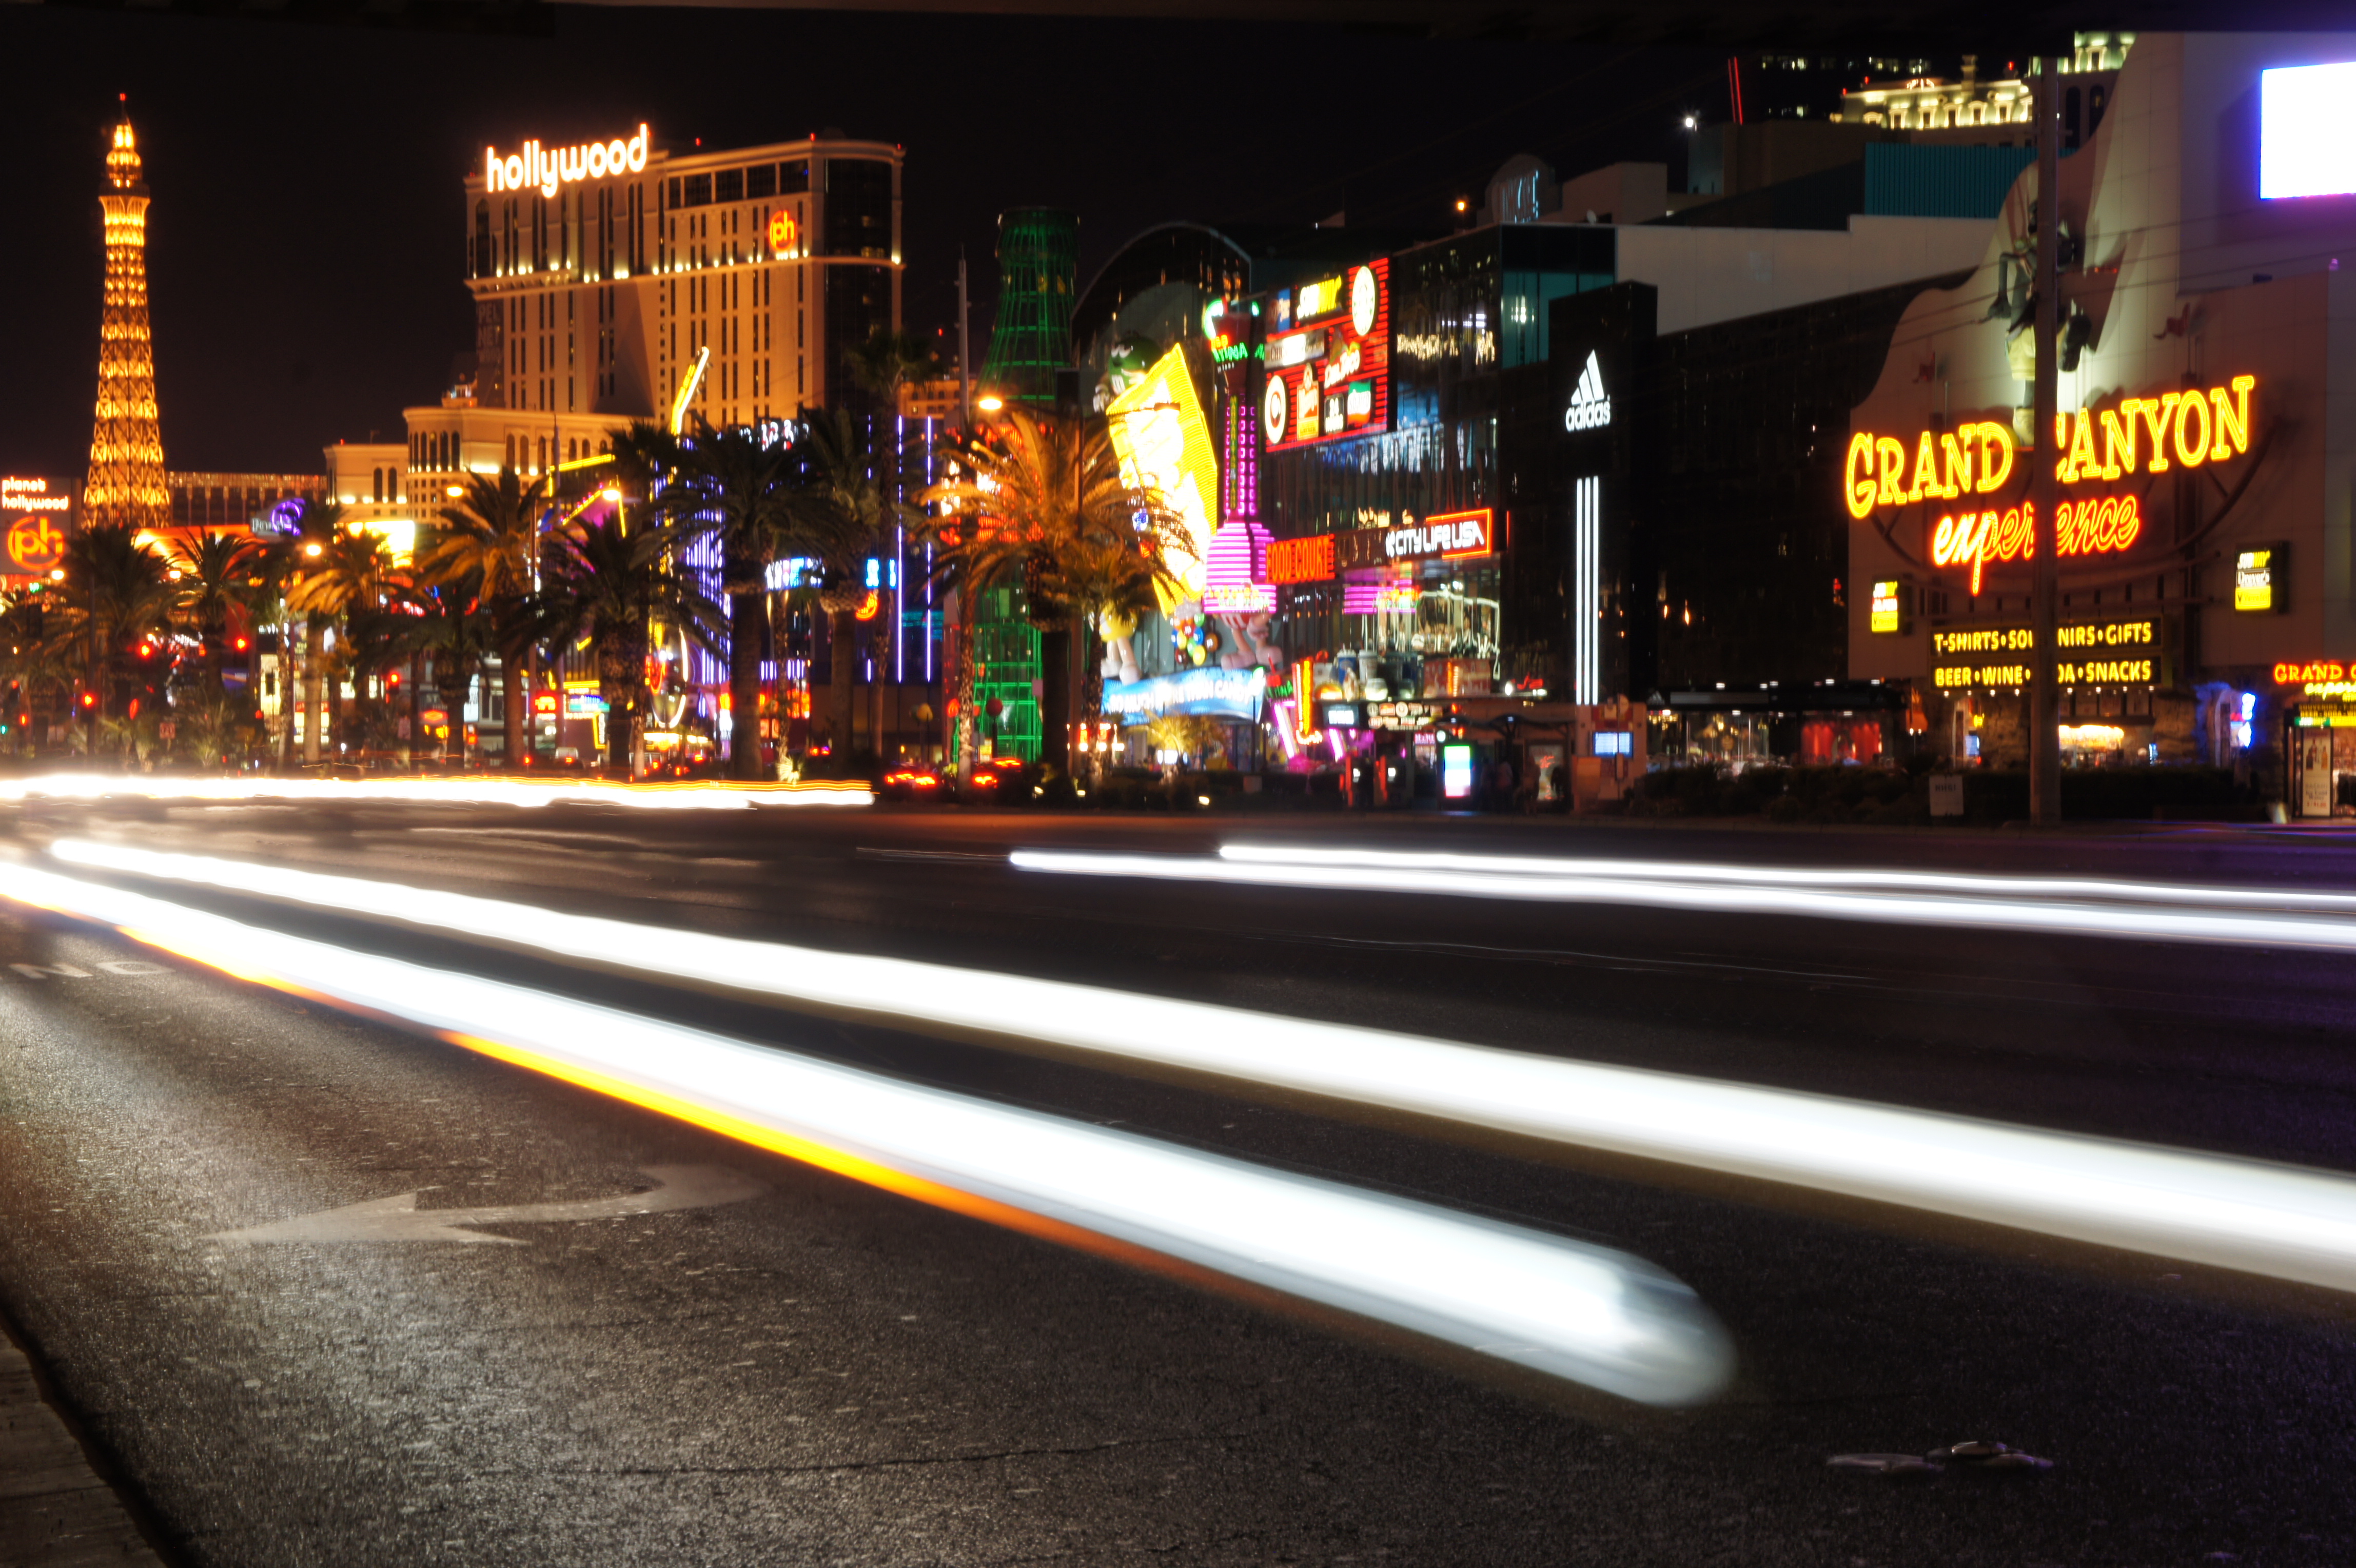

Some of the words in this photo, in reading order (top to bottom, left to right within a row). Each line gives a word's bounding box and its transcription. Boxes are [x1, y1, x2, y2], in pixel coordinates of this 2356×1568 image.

[487, 123, 647, 198] hollywood
[1297, 275, 1342, 319] SUBWAY
[1565, 397, 1611, 432] adidas
[2, 476, 46, 494] planet
[1846, 421, 2013, 518] GRAND
[2, 494, 69, 513] hollywood
[1396, 527, 1422, 556] CITY
[1451, 520, 1485, 548] USA
[1933, 494, 2139, 595] experence
[1267, 541, 1292, 584] FOOD
[1295, 535, 1330, 580] COURT
[2237, 550, 2270, 570] SUBWAY
[1934, 631, 1999, 653] T-SHIRTS
[2008, 625, 2095, 651] SONIRS
[2105, 622, 2151, 645] GIFTS
[1935, 667, 1972, 687] BEER
[1982, 665, 2023, 686] WINE
[2058, 663, 2075, 683] DA
[2086, 660, 2151, 683] SNACKS
[2274, 663, 2343, 683] GRAND
